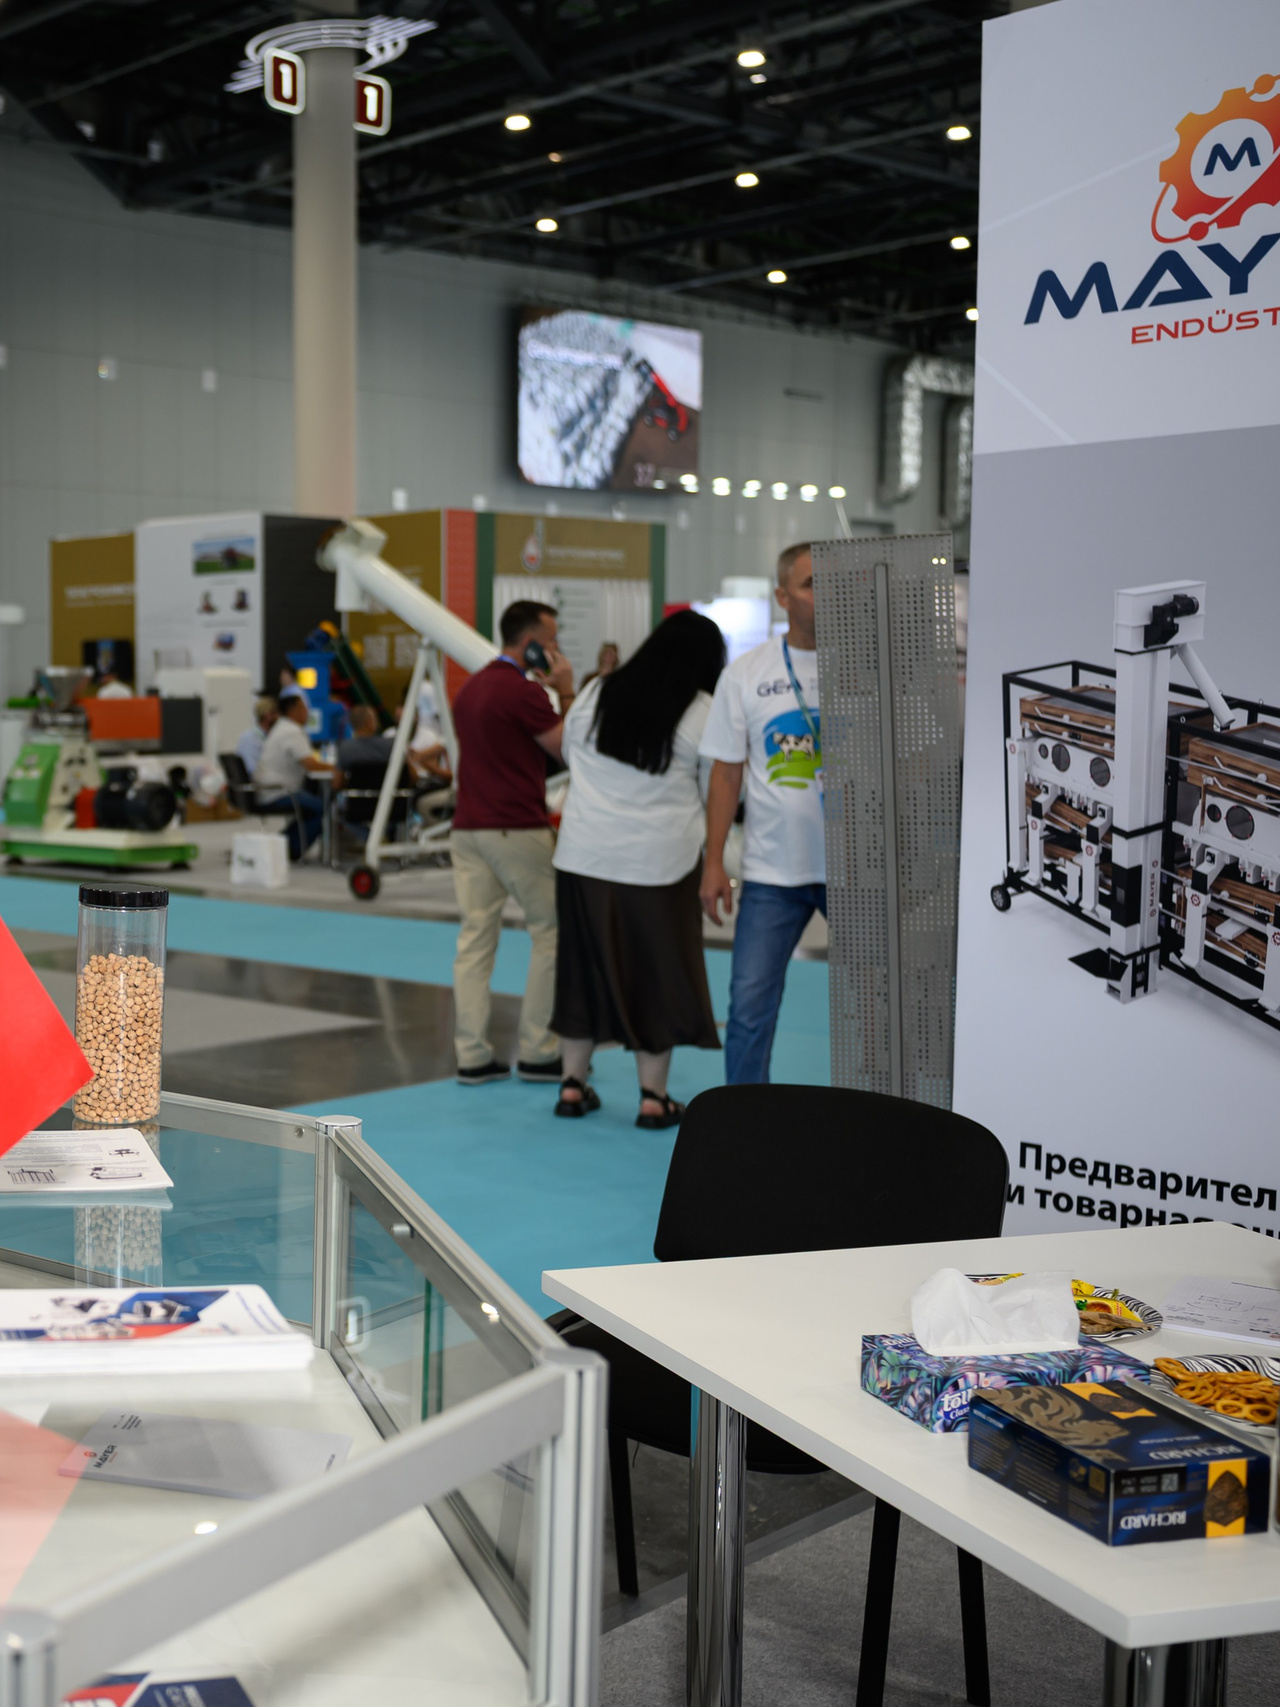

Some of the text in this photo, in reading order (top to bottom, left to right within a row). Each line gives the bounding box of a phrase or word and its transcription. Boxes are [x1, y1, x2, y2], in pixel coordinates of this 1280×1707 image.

[1203, 136, 1262, 177] M
[1018, 1140, 1278, 1212] Предварител
[1006, 1183, 1214, 1229] и товарна
[93, 1444, 118, 1469] MAYER
[1120, 1510, 1187, 1530] RICHARD
